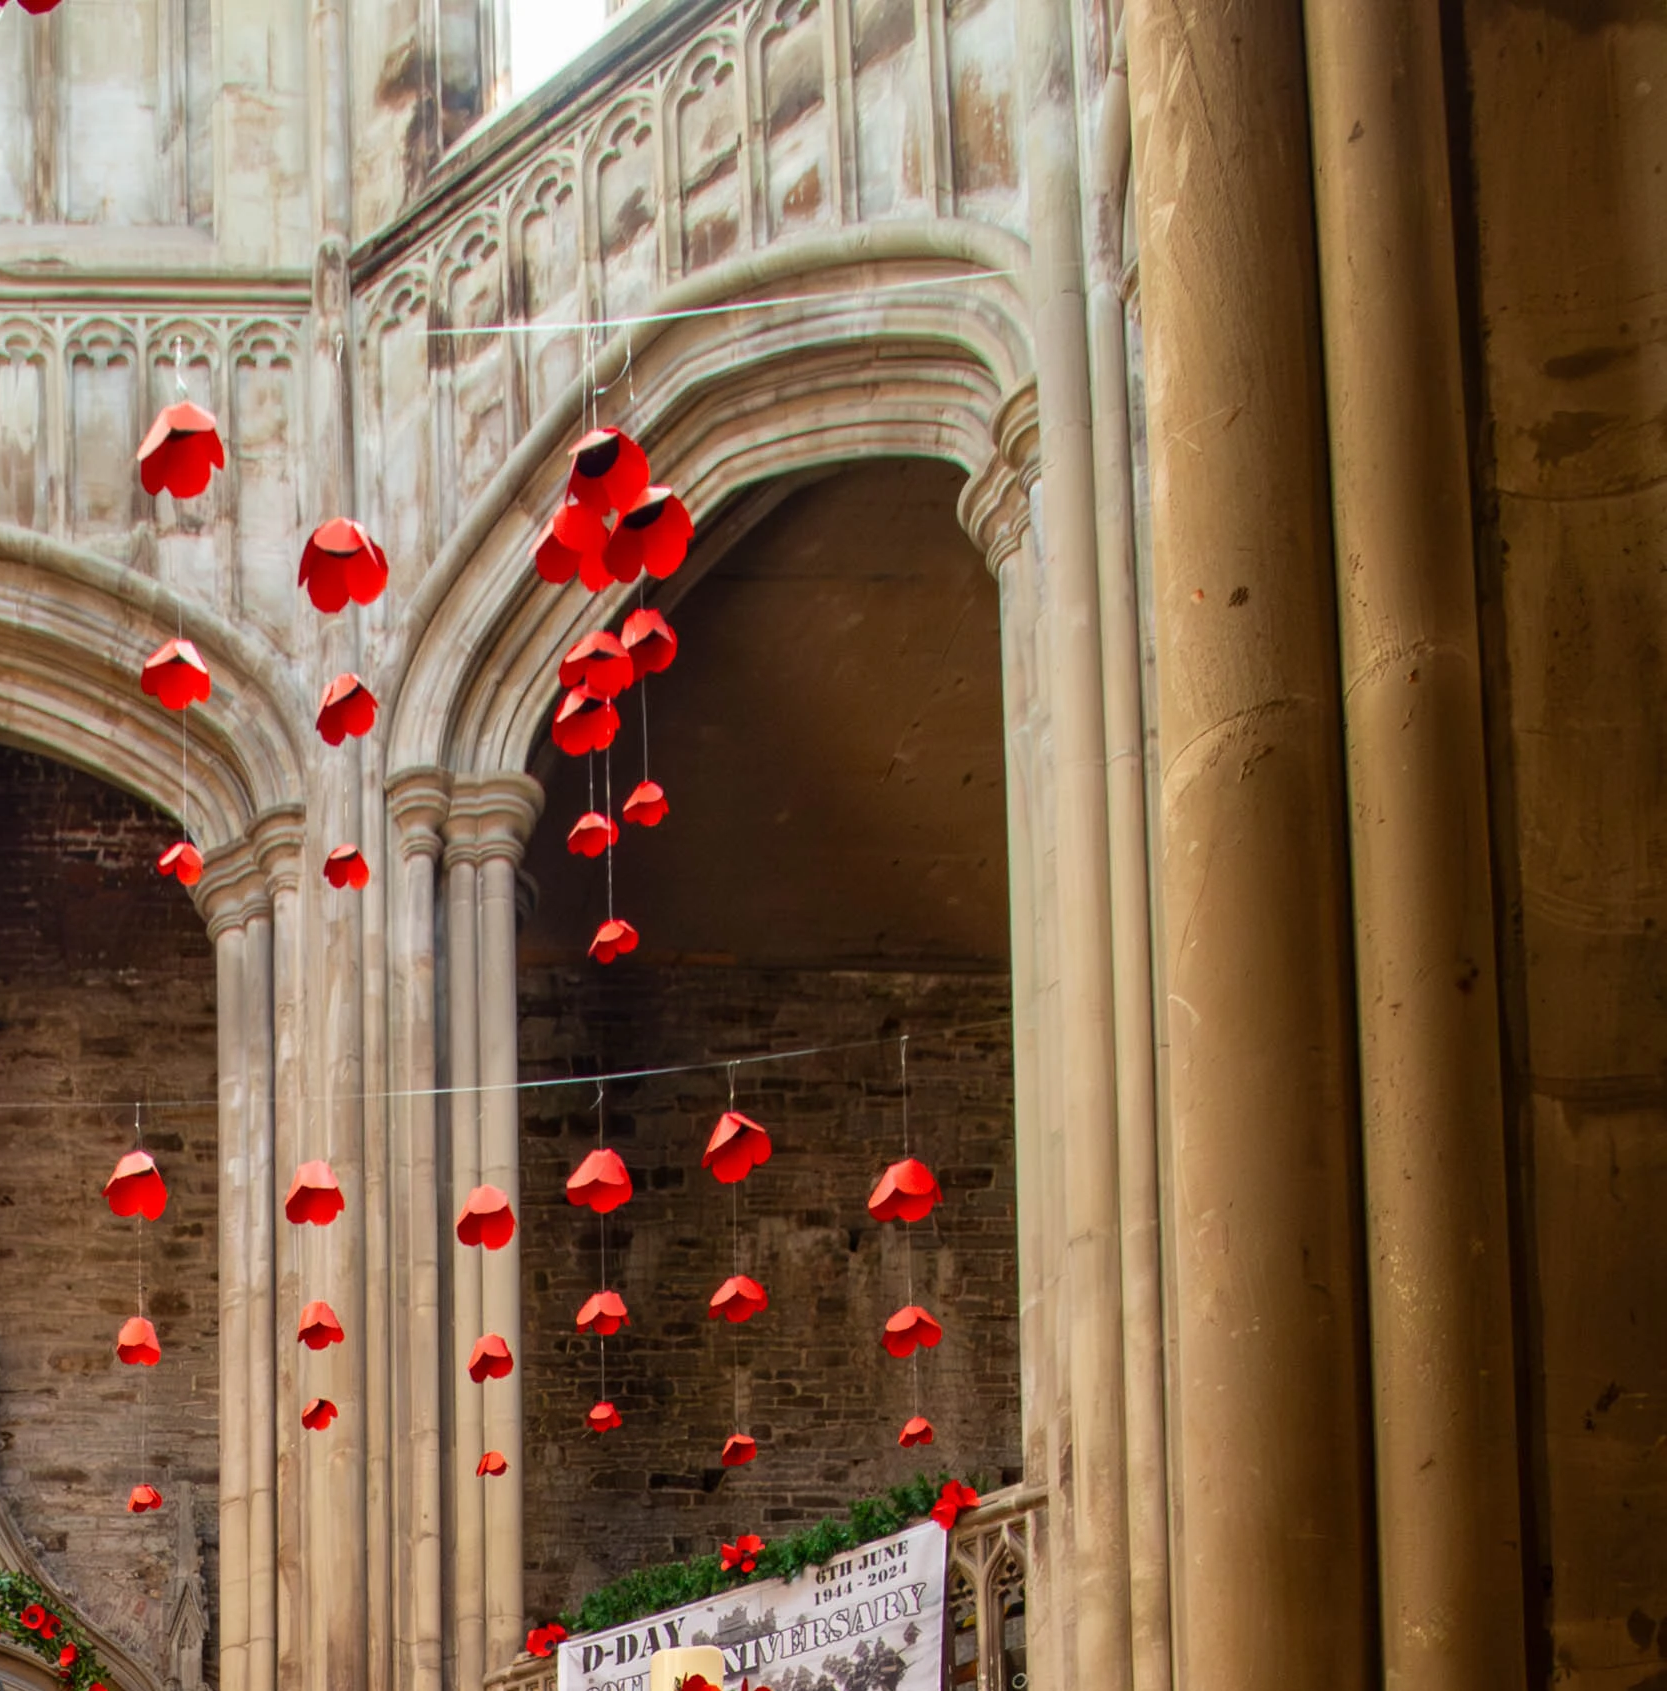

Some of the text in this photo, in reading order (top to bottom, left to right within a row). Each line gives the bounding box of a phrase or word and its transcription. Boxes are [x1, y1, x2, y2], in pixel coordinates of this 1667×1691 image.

[814, 1581, 853, 1606] 1944
[867, 1561, 908, 1588] 2024
[815, 1540, 909, 1585] 6TH JUNE
[582, 1616, 686, 1674] D-DAY
[721, 1582, 927, 1677] NIVERSARY
